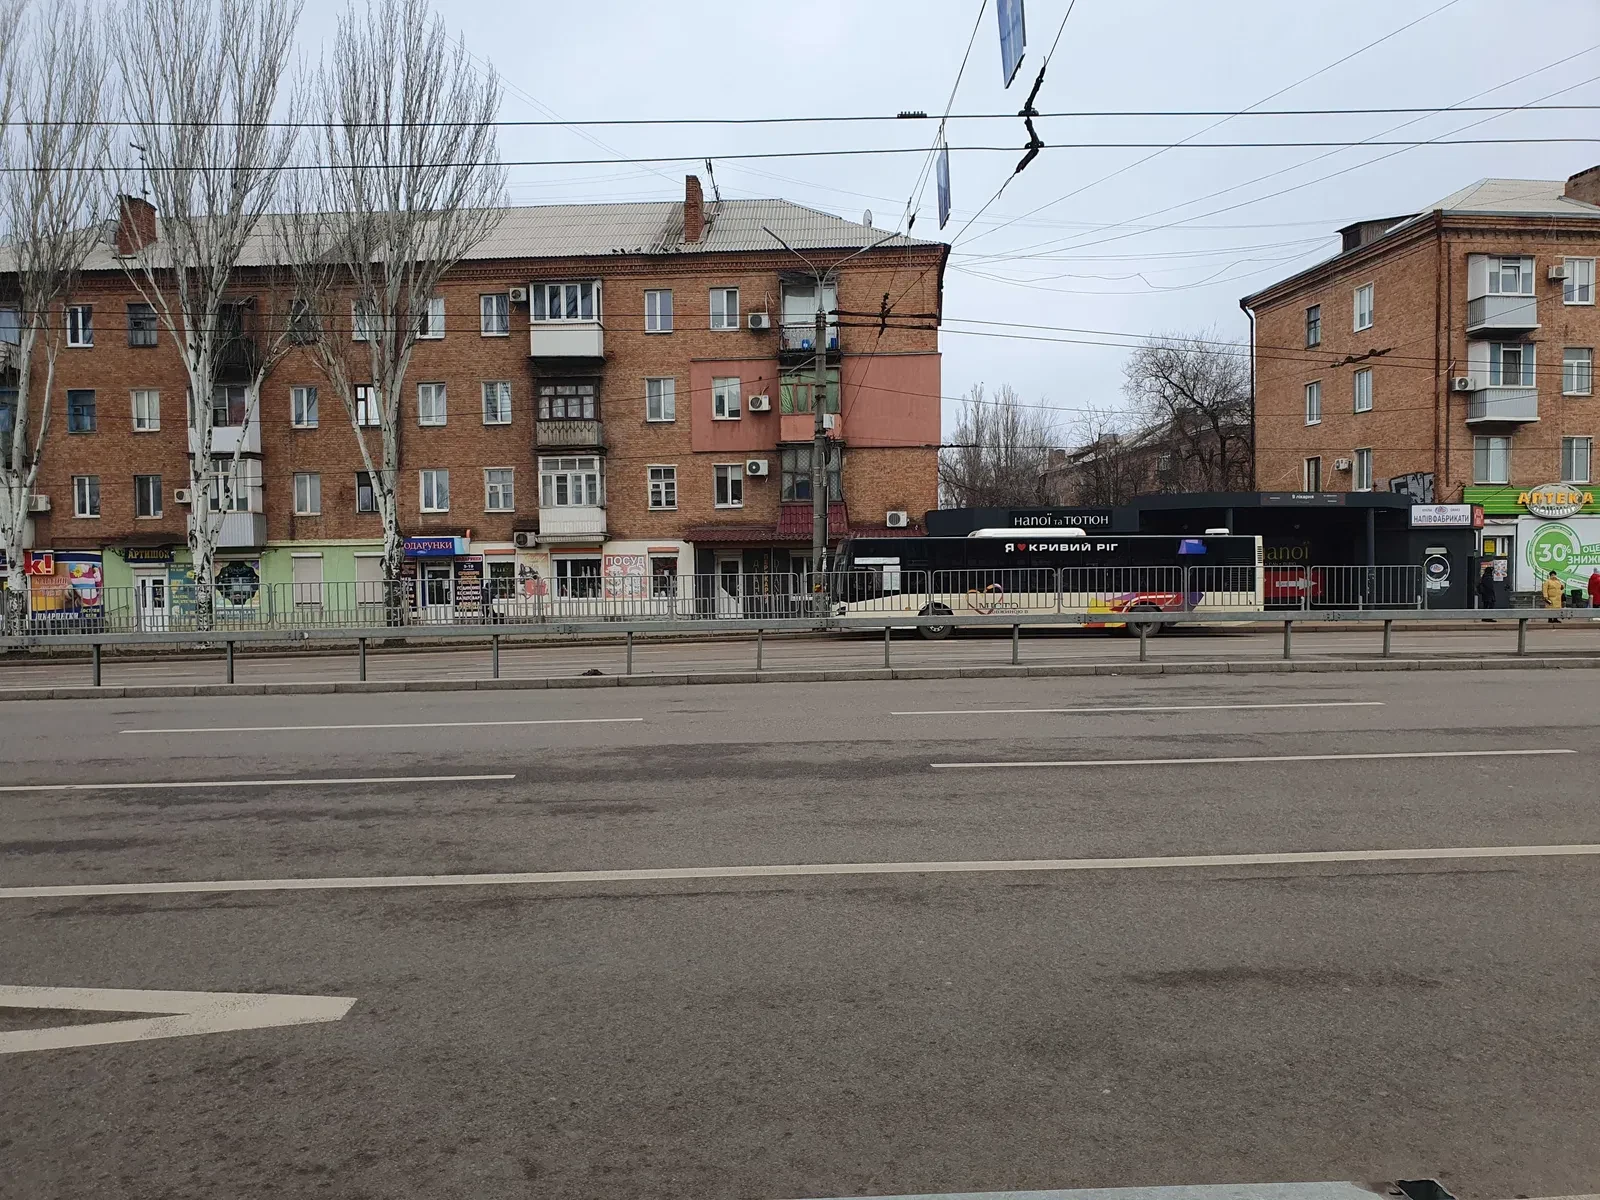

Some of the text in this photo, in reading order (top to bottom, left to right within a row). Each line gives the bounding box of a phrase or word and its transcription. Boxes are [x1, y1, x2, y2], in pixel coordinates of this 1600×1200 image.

[1517, 492, 1594, 505] АПТЕКА
[1063, 515, 1109, 525] ТЮТЮН
[1413, 514, 1470, 523] НАПІВФАБРИКАТИ
[403, 541, 453, 551] ОДАРУНКИ
[1005, 542, 1119, 553] Я КРИВИЙ РІГ
[605, 556, 645, 567] ПОСУД
